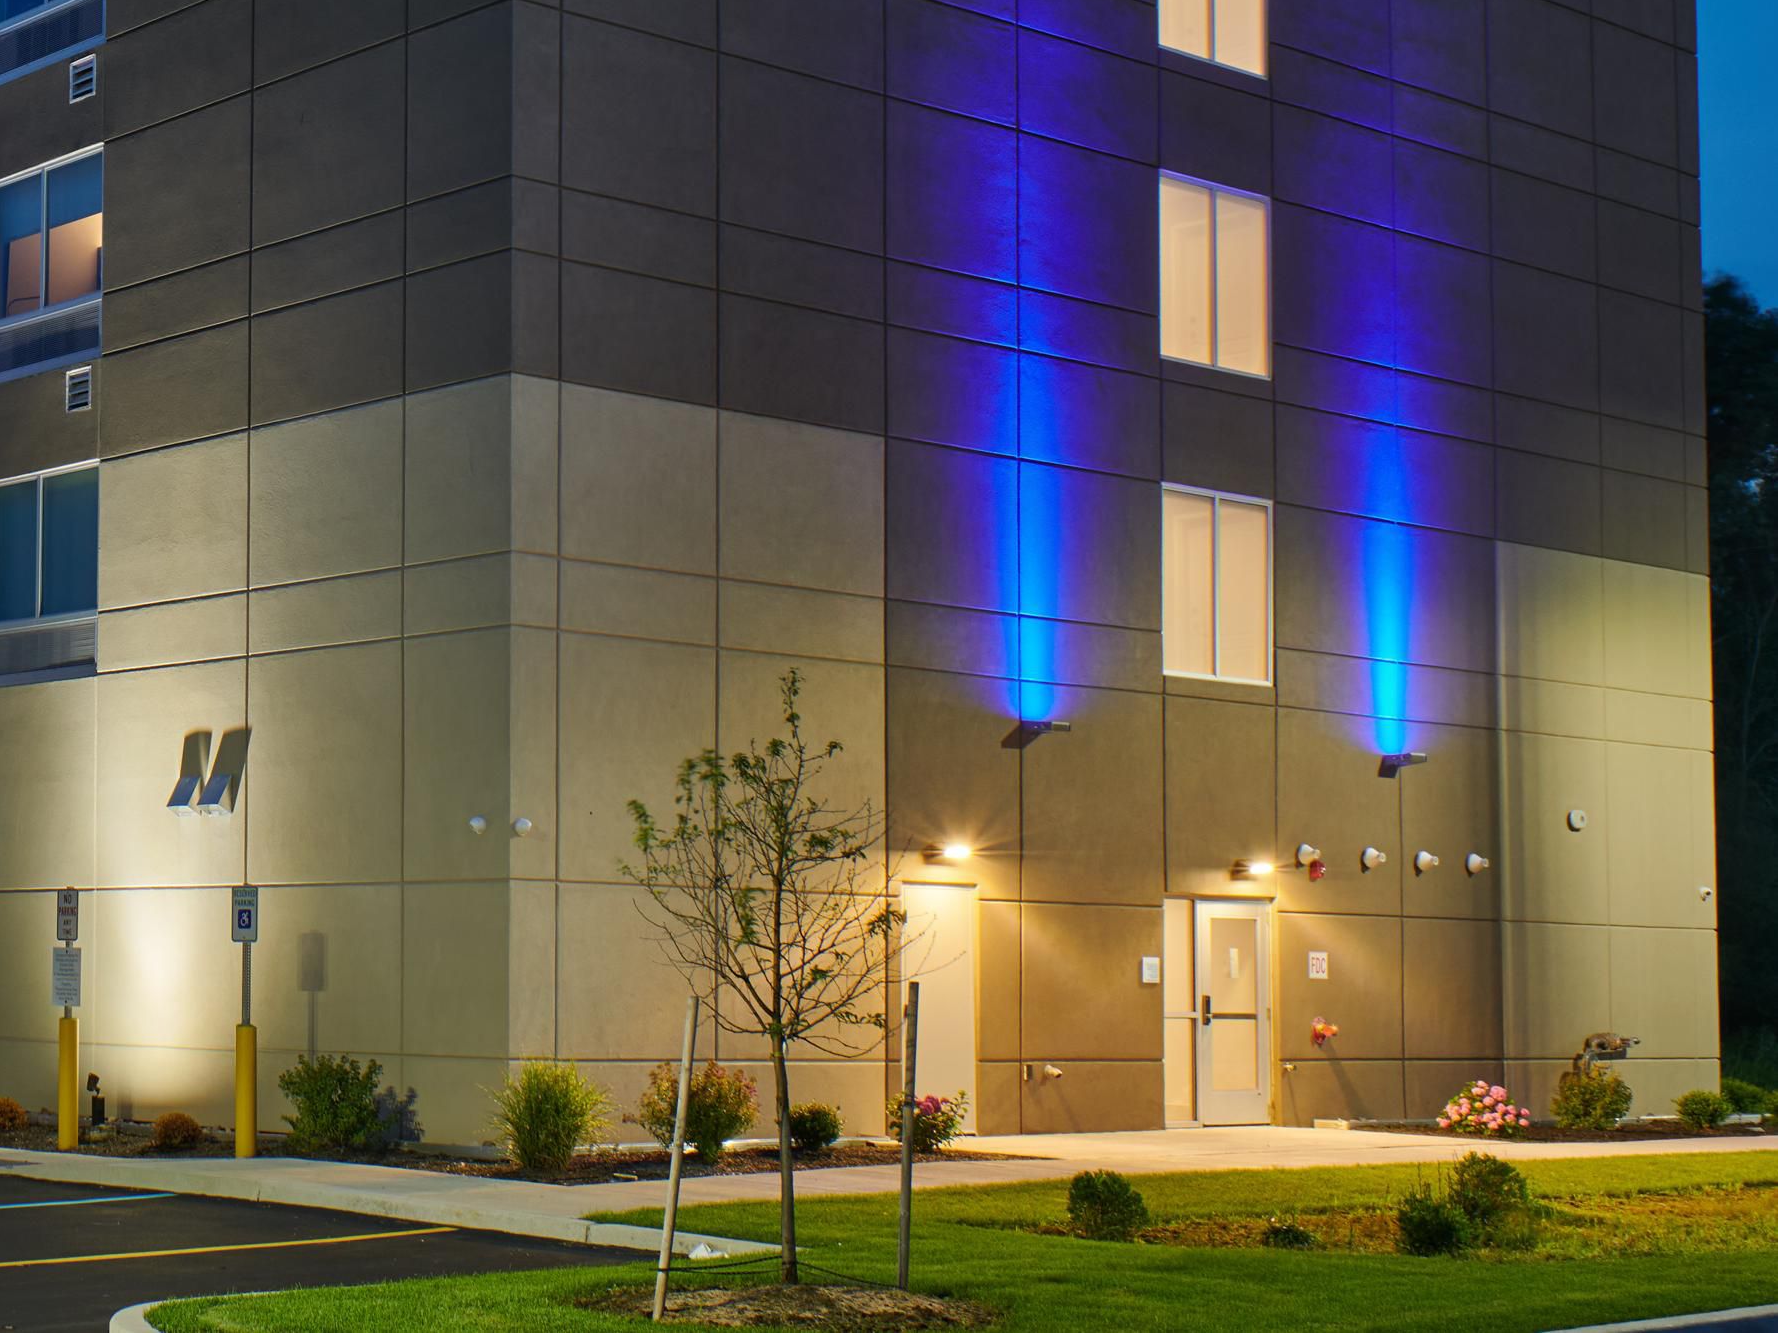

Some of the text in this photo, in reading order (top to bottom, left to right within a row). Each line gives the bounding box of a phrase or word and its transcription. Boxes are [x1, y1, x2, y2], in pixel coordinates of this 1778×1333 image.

[63, 894, 72, 905] NO
[235, 898, 255, 906] PARKING
[58, 906, 78, 916] PARKING
[1311, 956, 1326, 974] FDC
